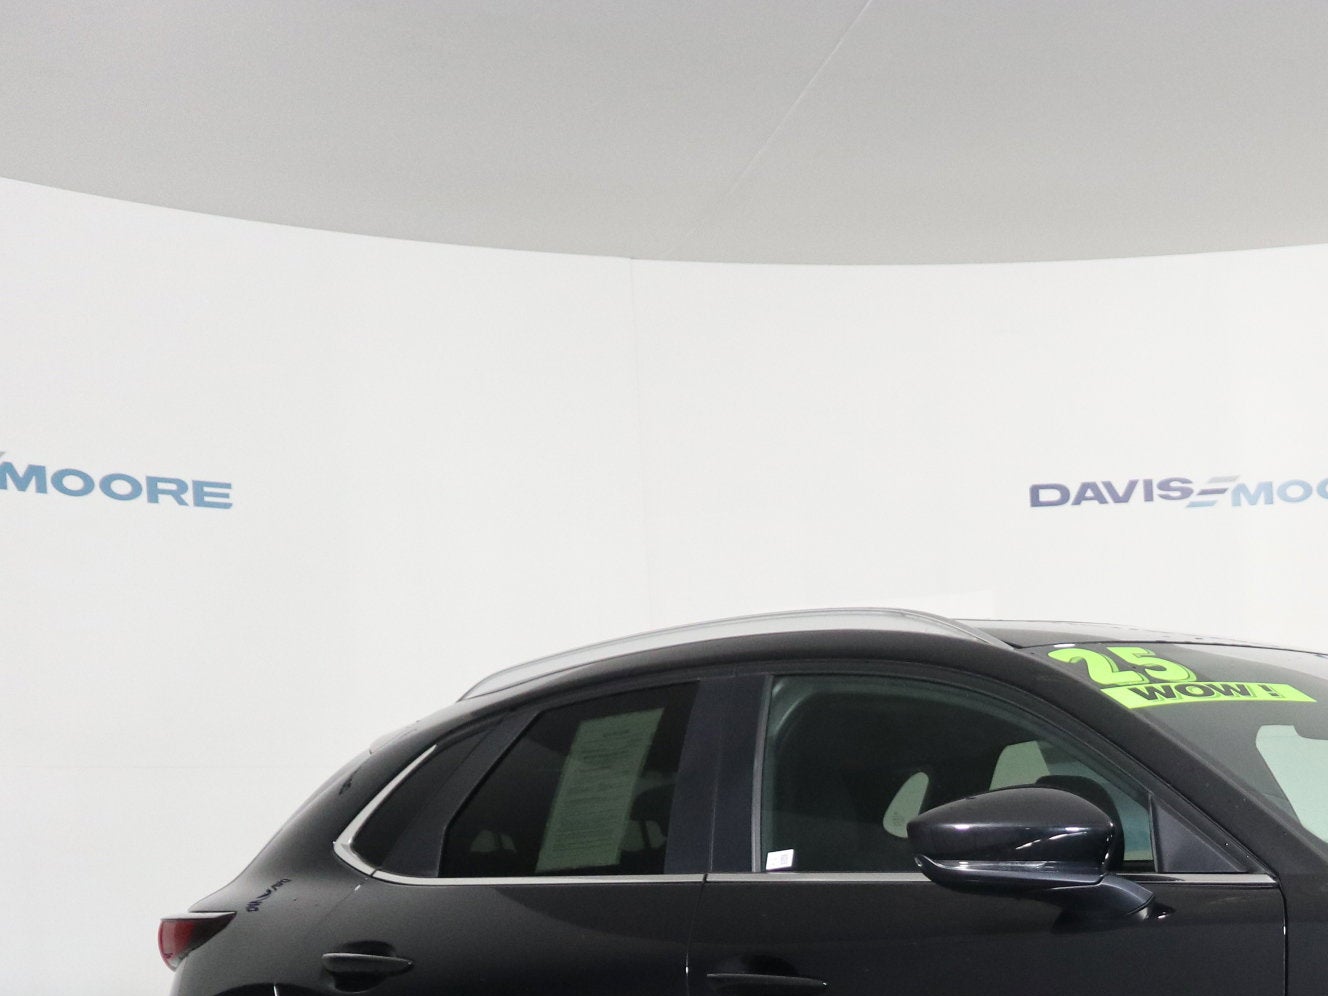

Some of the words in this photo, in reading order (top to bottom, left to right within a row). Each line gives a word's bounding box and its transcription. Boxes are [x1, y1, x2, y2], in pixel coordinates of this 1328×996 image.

[0, 461, 233, 510] MOORE
[1029, 476, 1193, 508] DAVIS
[1047, 646, 1197, 686] 25
